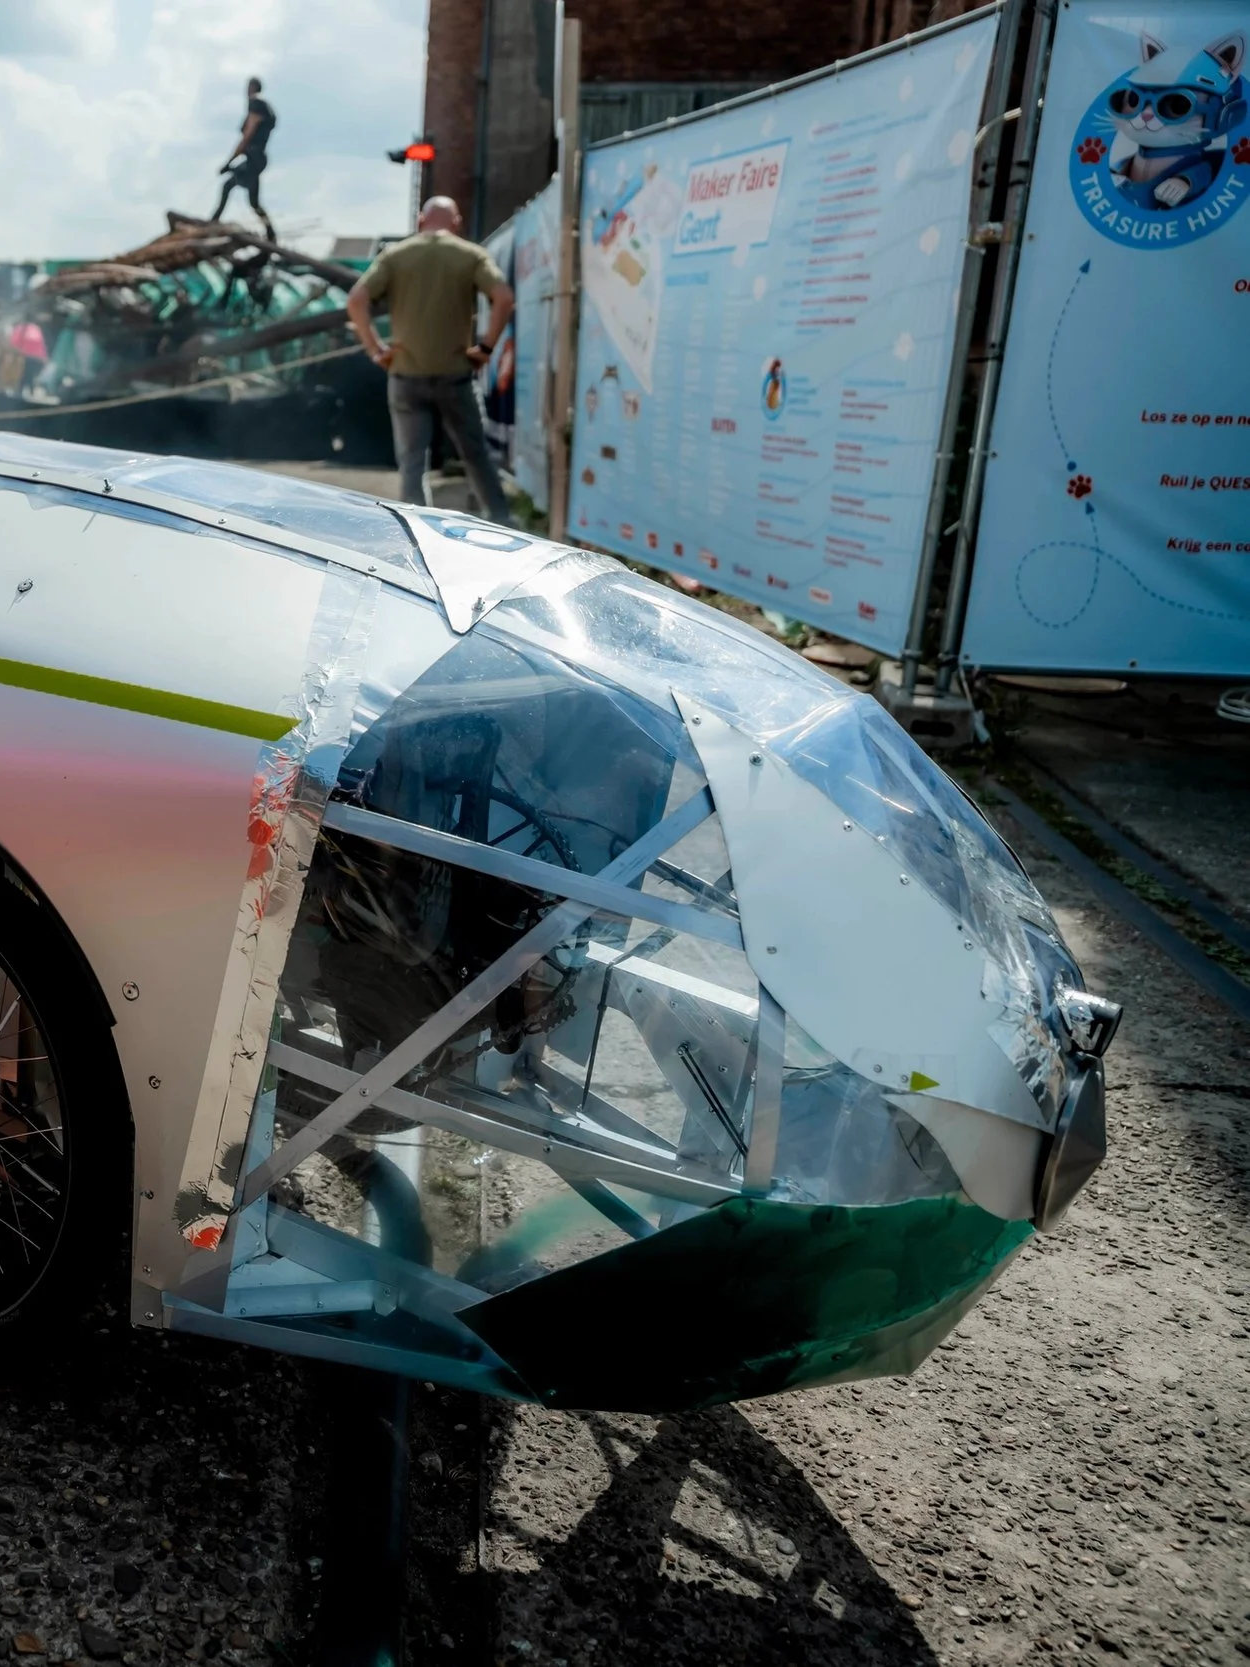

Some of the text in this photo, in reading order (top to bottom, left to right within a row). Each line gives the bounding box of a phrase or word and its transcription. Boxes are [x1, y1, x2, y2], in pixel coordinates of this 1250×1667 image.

[689, 166, 735, 203] Maker
[737, 158, 779, 193] Faire
[1080, 171, 1245, 240] TREASURE HUNT
[679, 208, 721, 245] Gent
[1141, 410, 1167, 423] Los
[1170, 412, 1187, 423] ze
[1191, 413, 1211, 427] op
[1214, 414, 1233, 425] en
[1160, 474, 1189, 487] Ruil
[1190, 475, 1206, 490] je
[1166, 537, 1202, 553] Krijg
[1205, 541, 1232, 552] een
